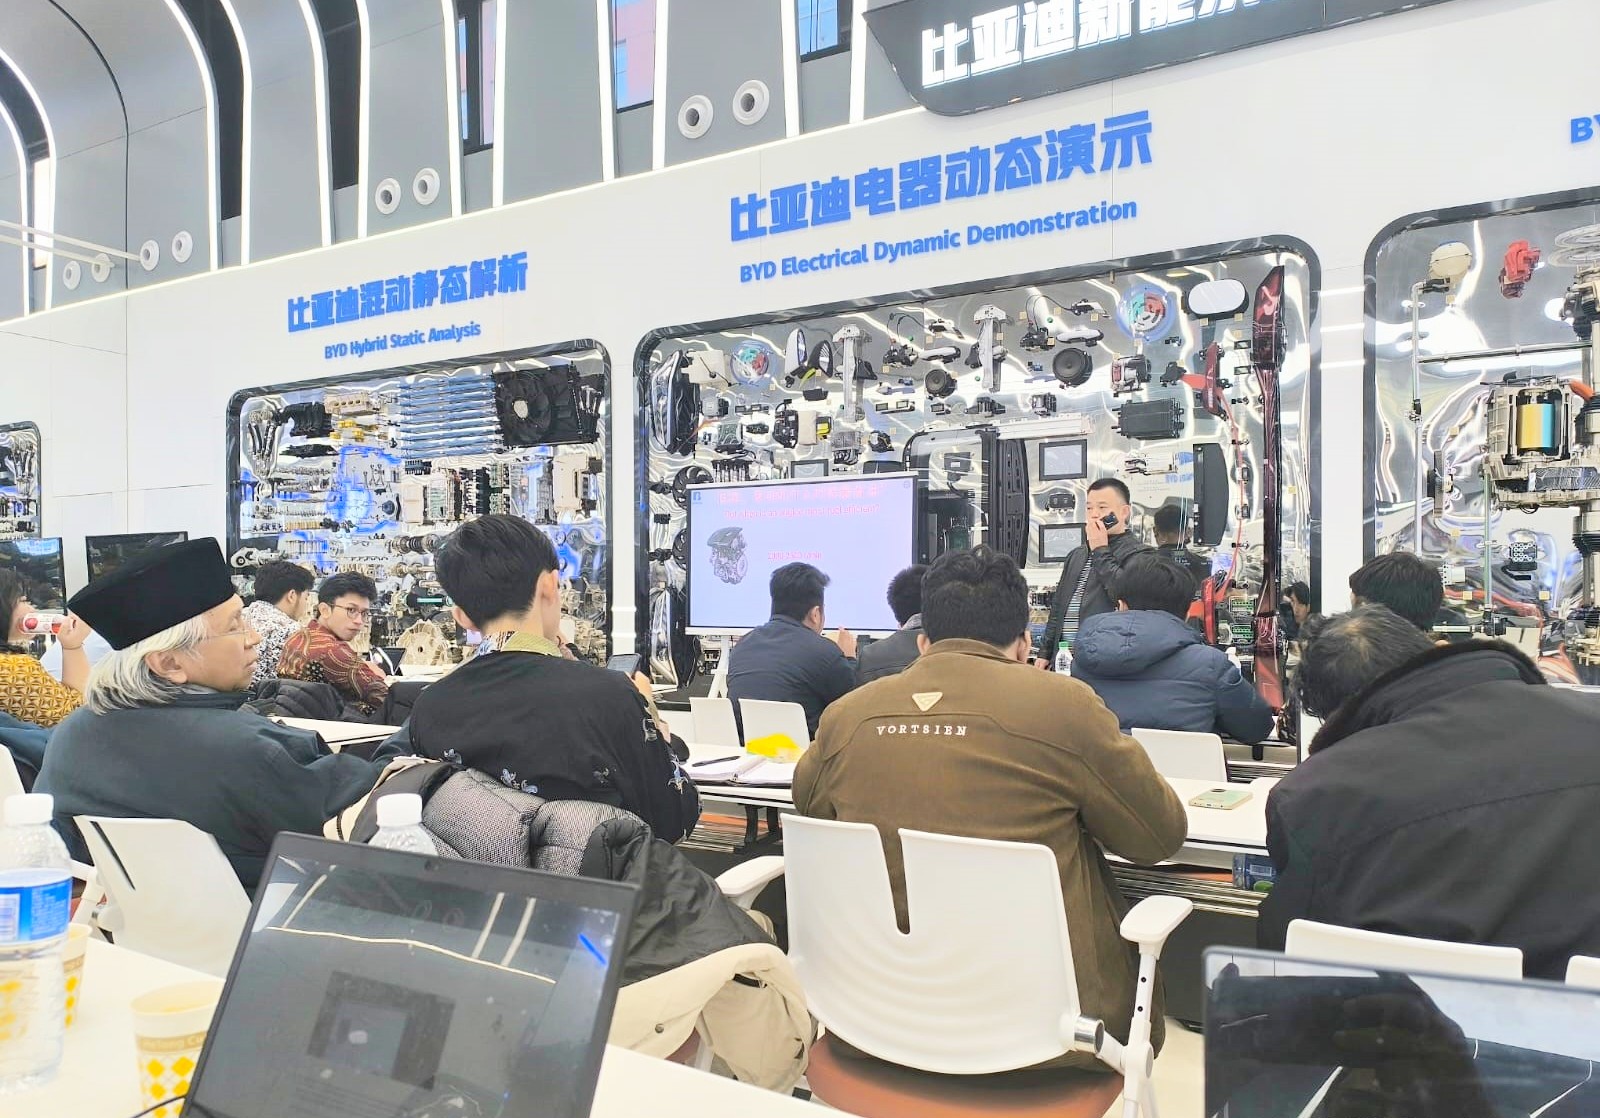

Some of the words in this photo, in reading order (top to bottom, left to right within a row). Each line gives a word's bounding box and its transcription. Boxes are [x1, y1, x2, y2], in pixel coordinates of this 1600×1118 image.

[921, 0, 1260, 89] 比亚迪新能
[1571, 114, 1600, 144] B
[730, 110, 1153, 242] 比亚迪电器动态演示
[740, 262, 776, 283] BYD
[782, 244, 868, 275] Electrical
[874, 228, 961, 263] Dynamic
[967, 200, 1137, 245] Demonstration
[287, 252, 528, 333] 比亚迪混动静态解析
[324, 343, 348, 360] BYD
[350, 335, 388, 358] Hybrid
[390, 330, 426, 349] Static
[428, 321, 481, 343] Analysis
[876, 724, 967, 736] VORTSIEN
